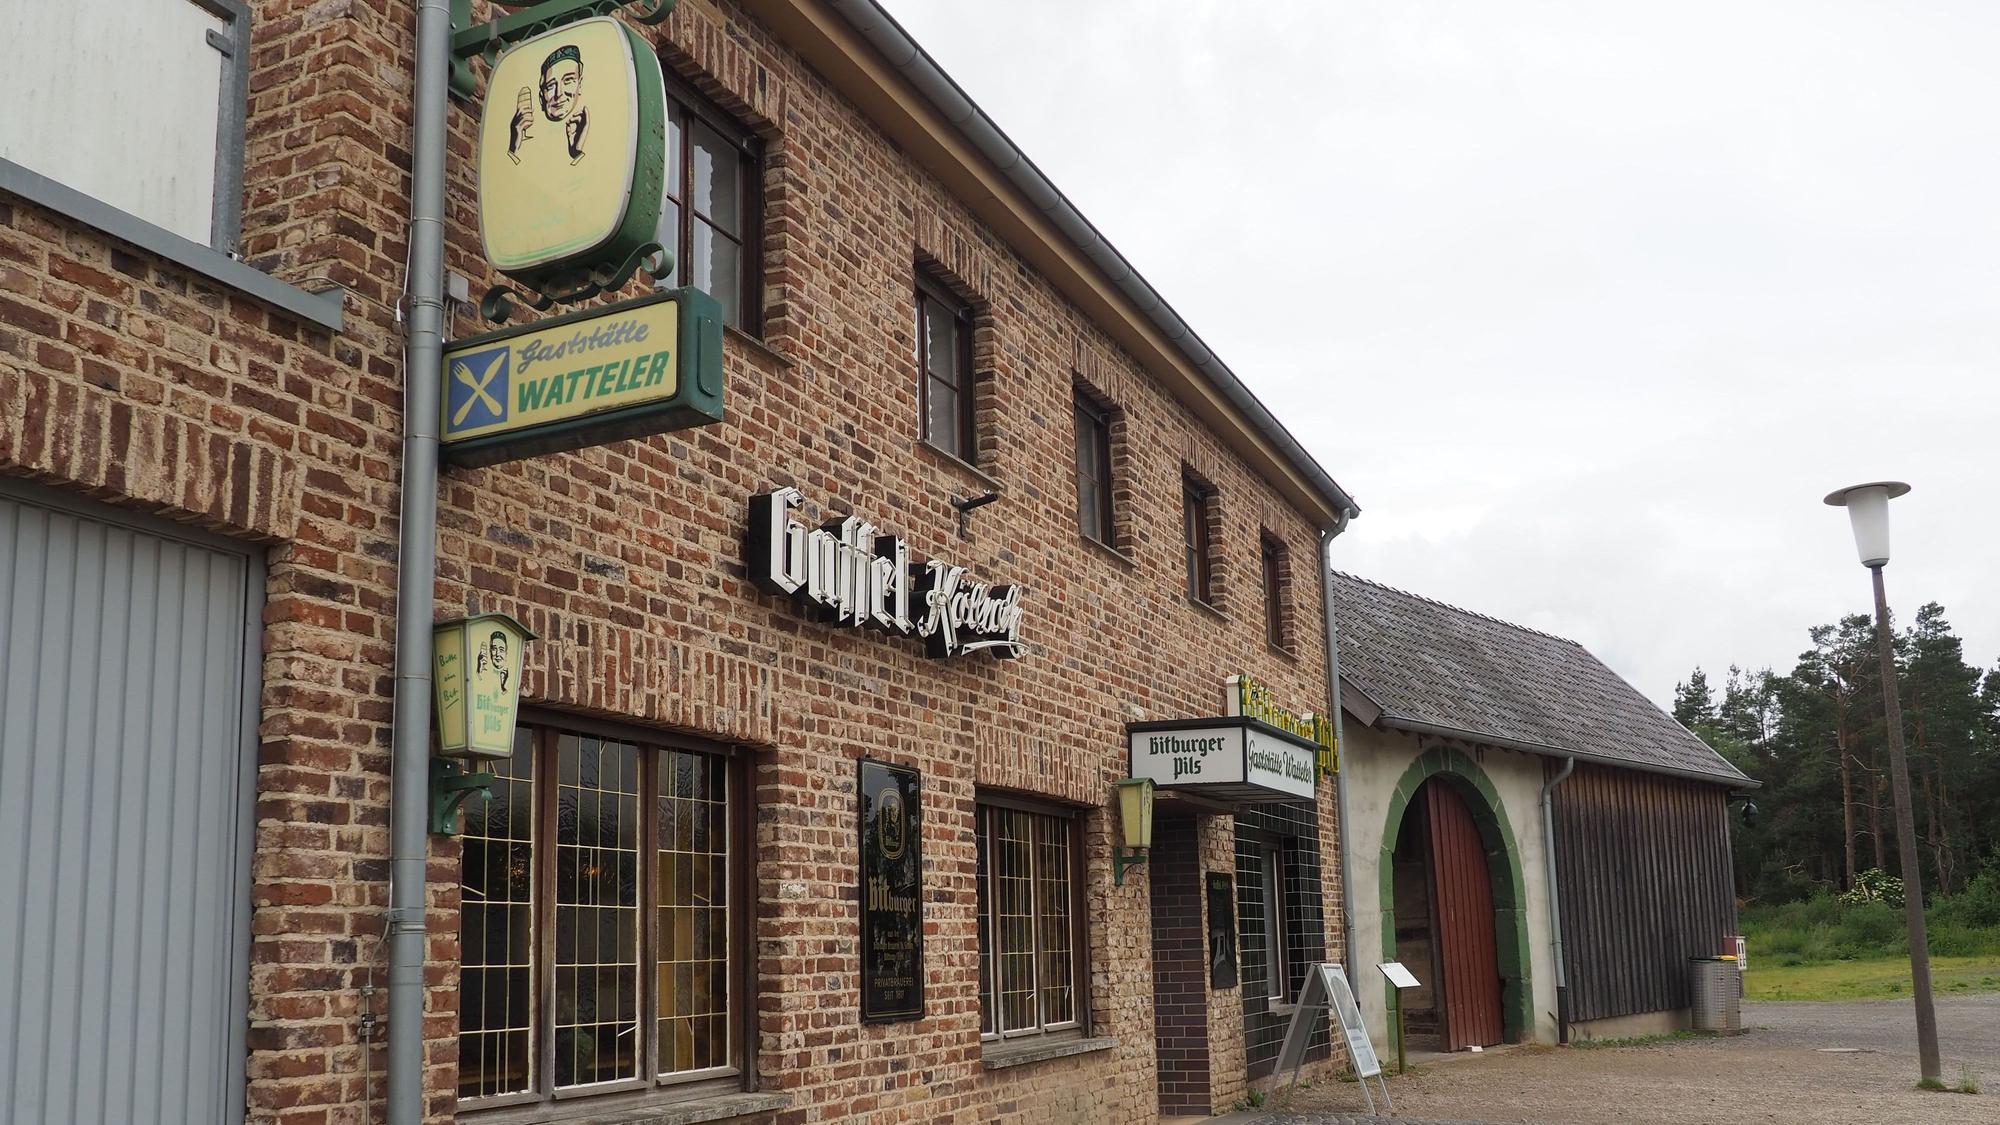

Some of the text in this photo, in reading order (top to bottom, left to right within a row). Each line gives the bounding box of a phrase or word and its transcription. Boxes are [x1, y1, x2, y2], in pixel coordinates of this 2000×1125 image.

[517, 320, 649, 375] Gaststätte
[518, 350, 670, 413] WATTELER
[769, 486, 1030, 659] Gaffel Kölsch
[1149, 734, 1225, 757] Bitburger
[1173, 756, 1202, 780] Pils
[1248, 739, 1283, 777] Gaststätte
[1282, 751, 1313, 785] Watteler
[868, 875, 917, 919] Bitburger
